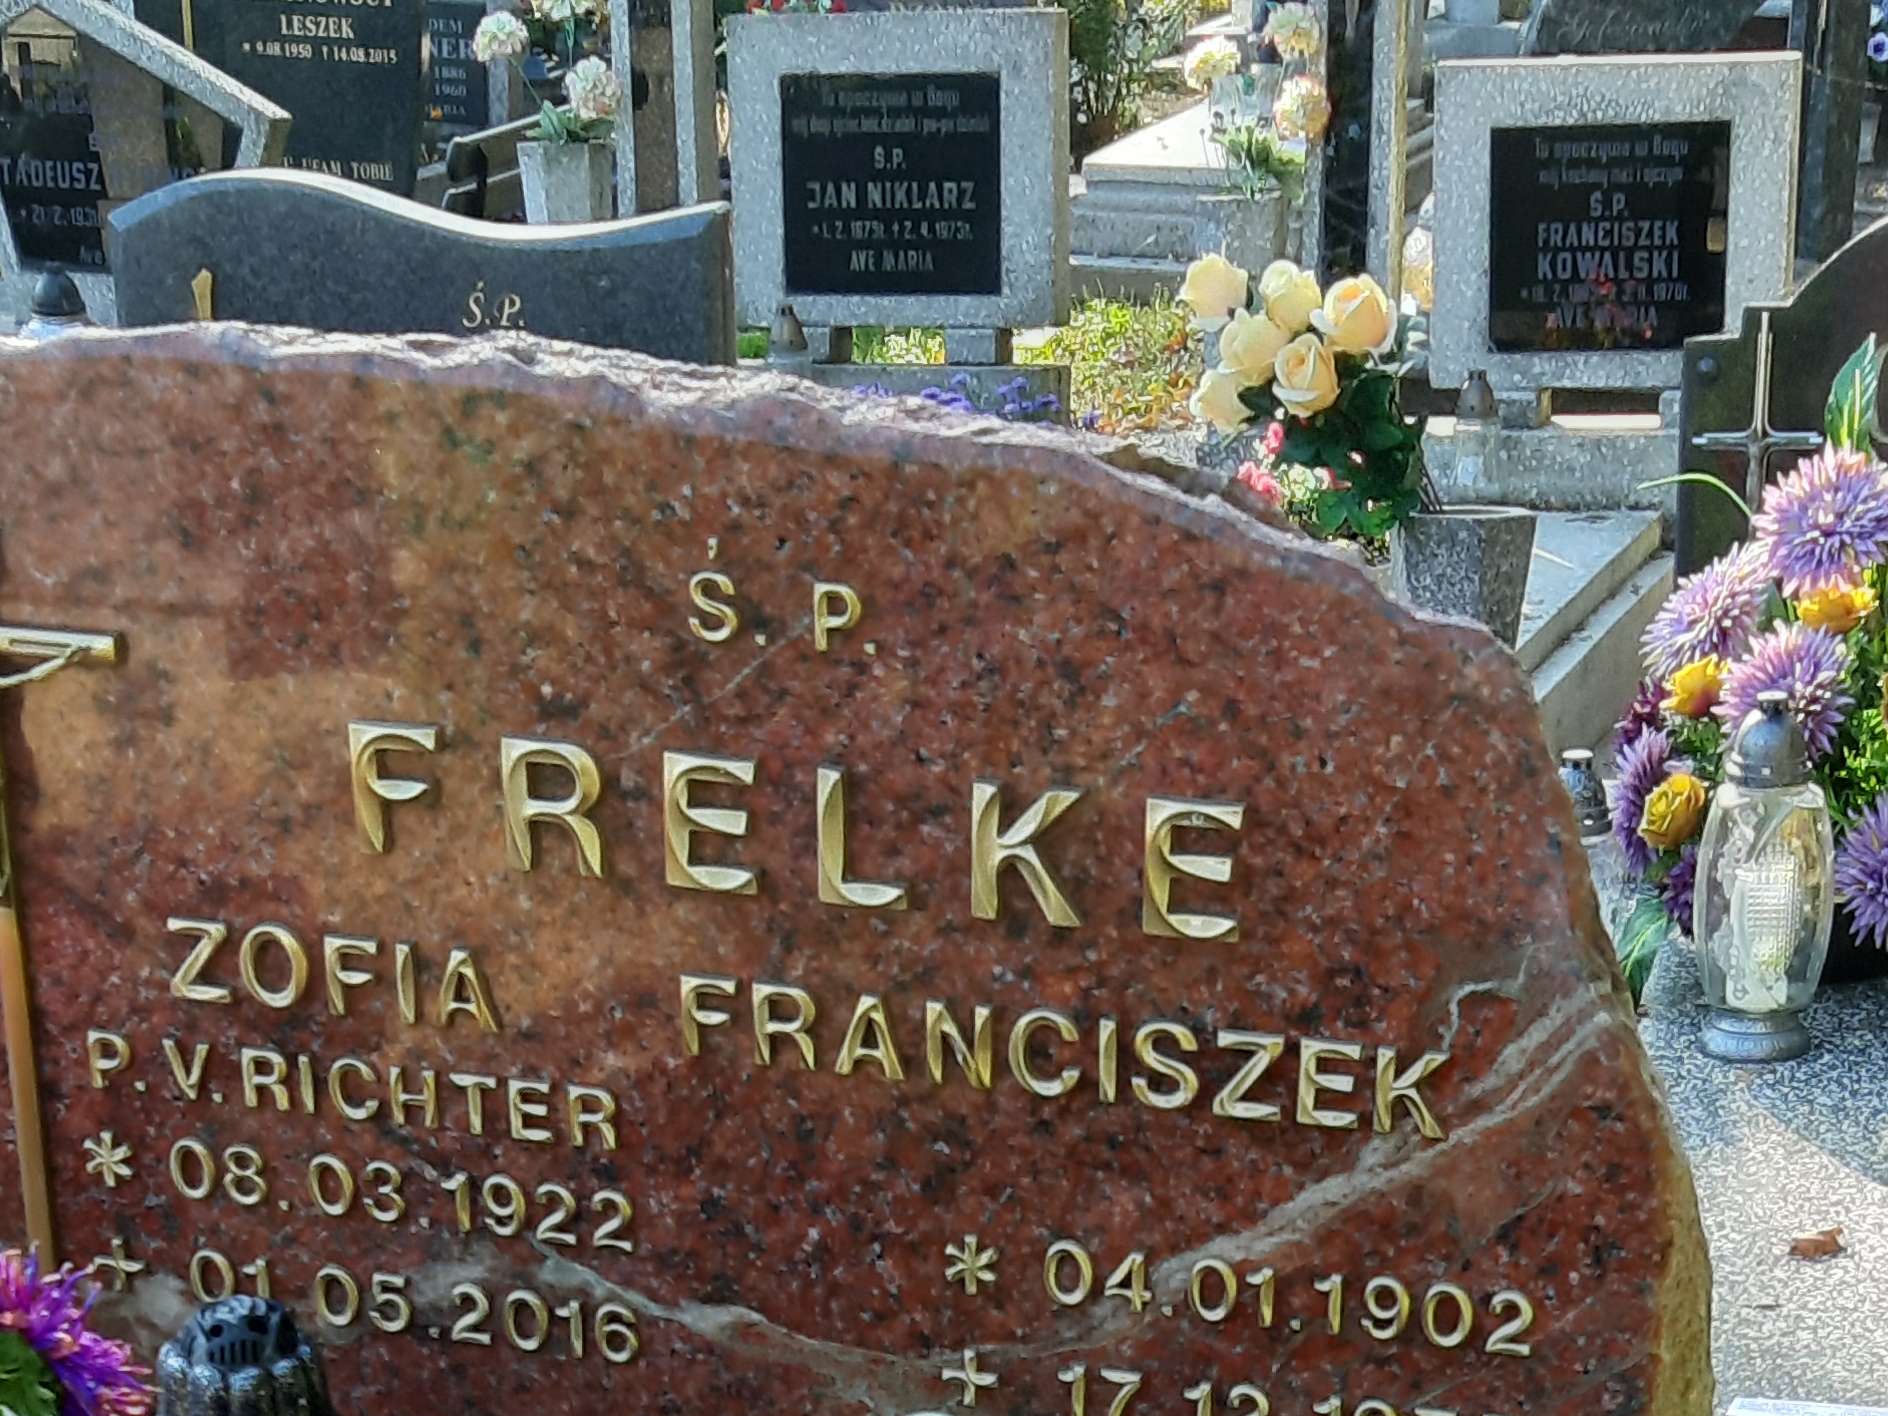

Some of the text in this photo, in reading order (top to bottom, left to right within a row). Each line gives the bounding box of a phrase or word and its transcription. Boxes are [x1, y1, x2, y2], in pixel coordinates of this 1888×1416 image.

[280, 13, 355, 39] LESZEK
[0, 157, 102, 191] TADEUSZ
[806, 181, 976, 210] JAN NIKLARZ
[1537, 220, 1679, 248] FRANCISZEK
[1537, 251, 1681, 281] KOWALSKI
[348, 720, 1247, 943] FRELKE
[166, 917, 500, 1033] ZOFIA
[679, 973, 1452, 1141] FRANCISZEK
[168, 1136, 635, 1253] 08.03.1922
[189, 1248, 640, 1364] 0105.2016
[1043, 1239, 1535, 1357] 04.01.1902
